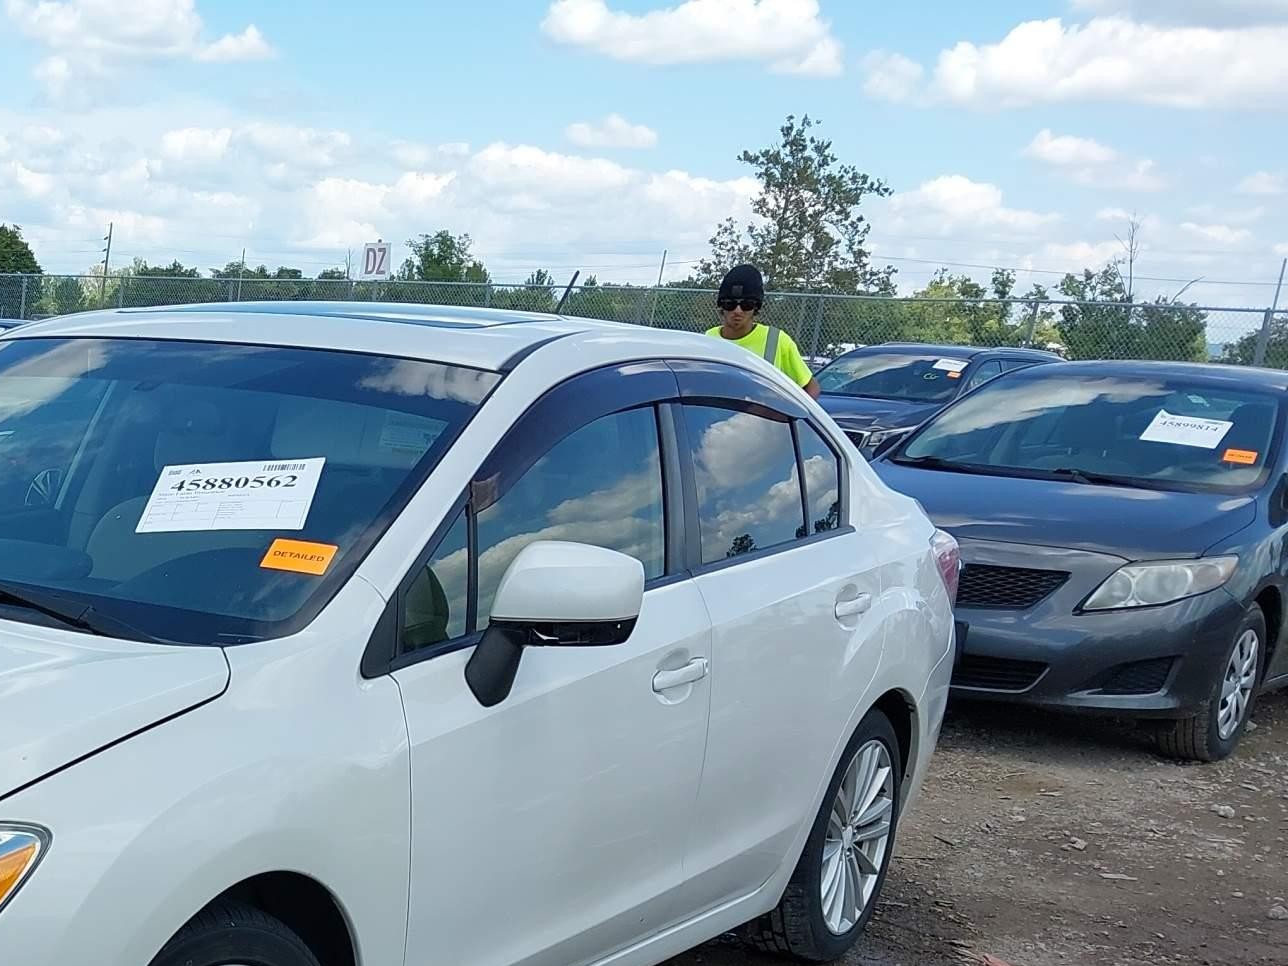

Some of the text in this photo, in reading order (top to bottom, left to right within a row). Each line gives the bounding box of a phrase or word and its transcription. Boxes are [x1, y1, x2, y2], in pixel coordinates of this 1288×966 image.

[364, 247, 387, 275] DZ
[170, 475, 298, 492] 45880562
[273, 550, 325, 562] DETAILED
